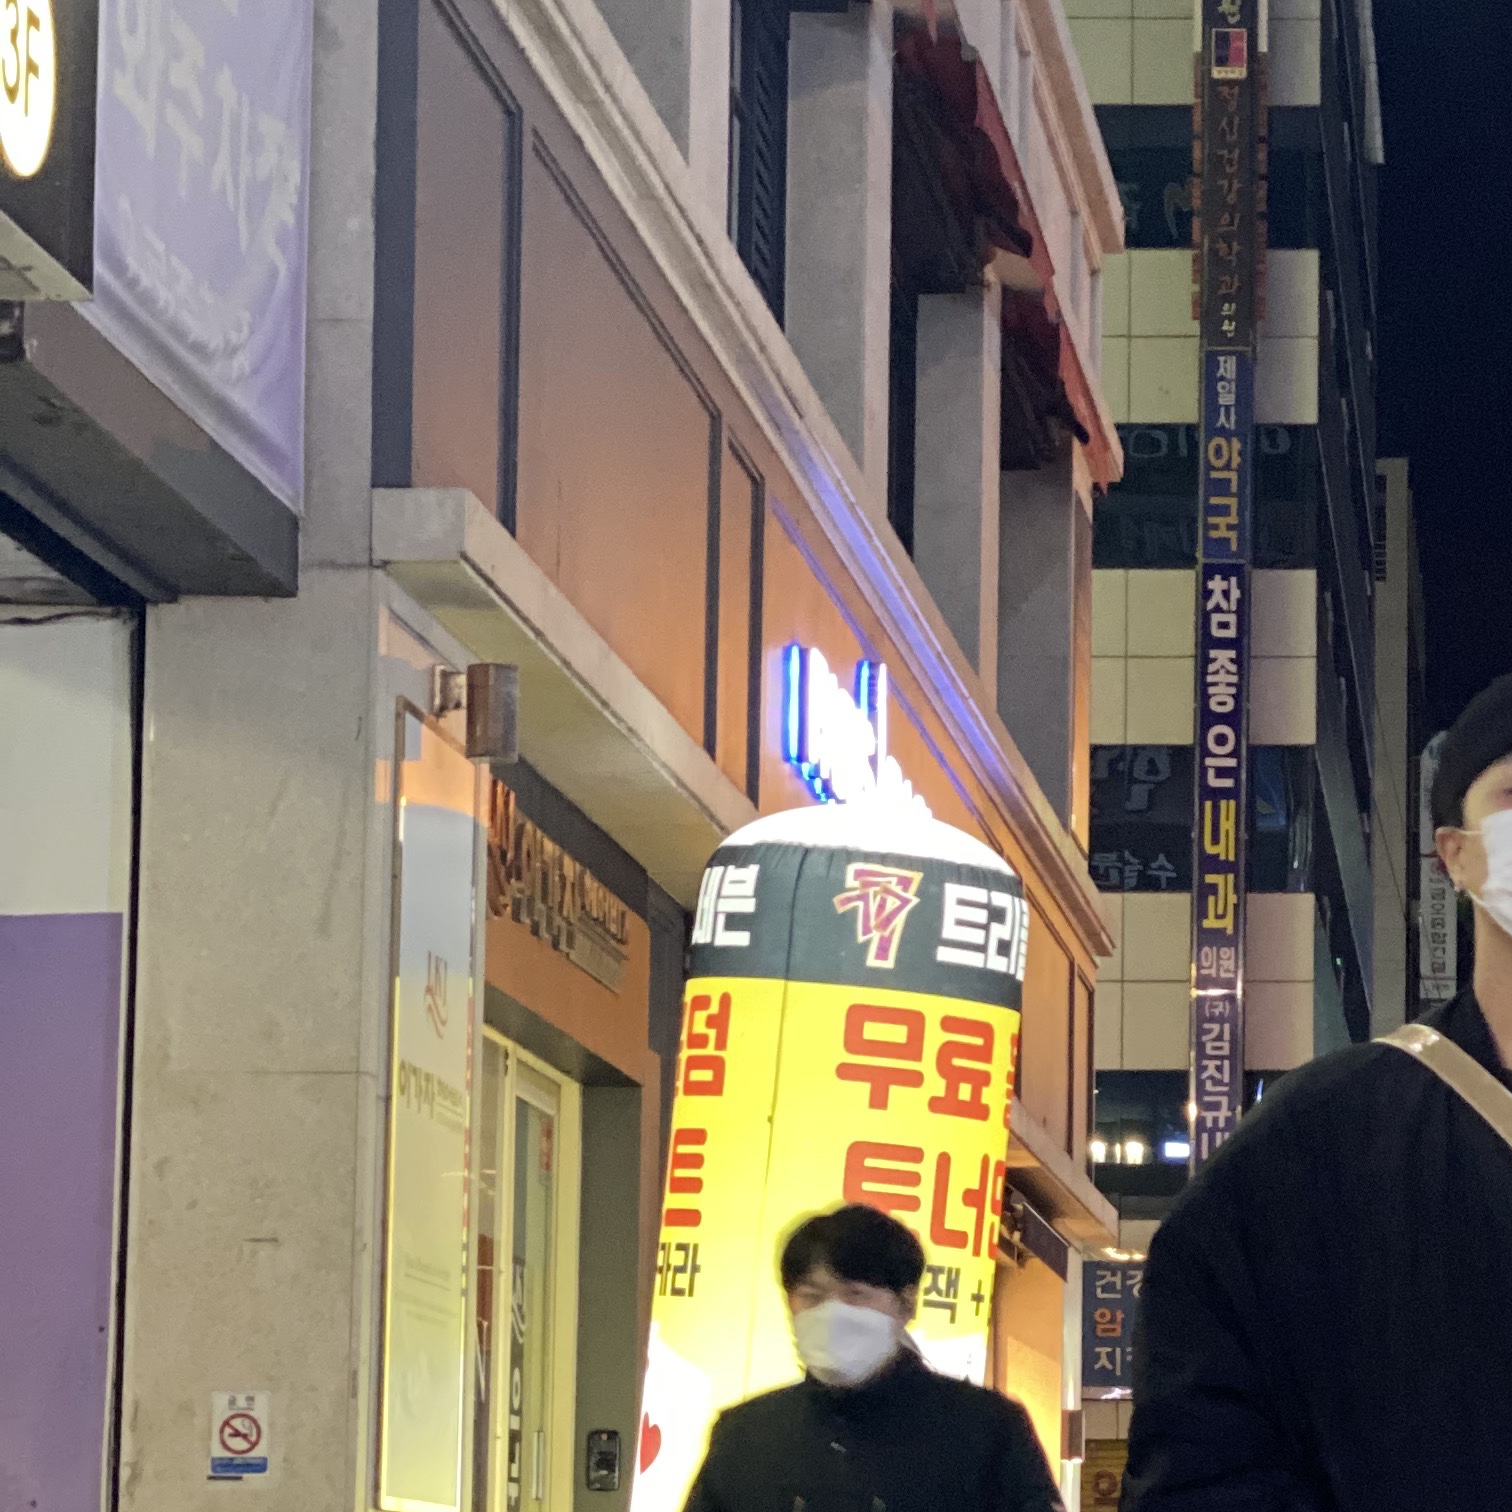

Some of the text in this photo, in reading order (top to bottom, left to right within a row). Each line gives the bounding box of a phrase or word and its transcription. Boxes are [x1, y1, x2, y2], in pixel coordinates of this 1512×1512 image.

[0, 0, 40, 118] 3F
[675, 991, 733, 1097] 덤
[835, 1002, 996, 1122] 무료
